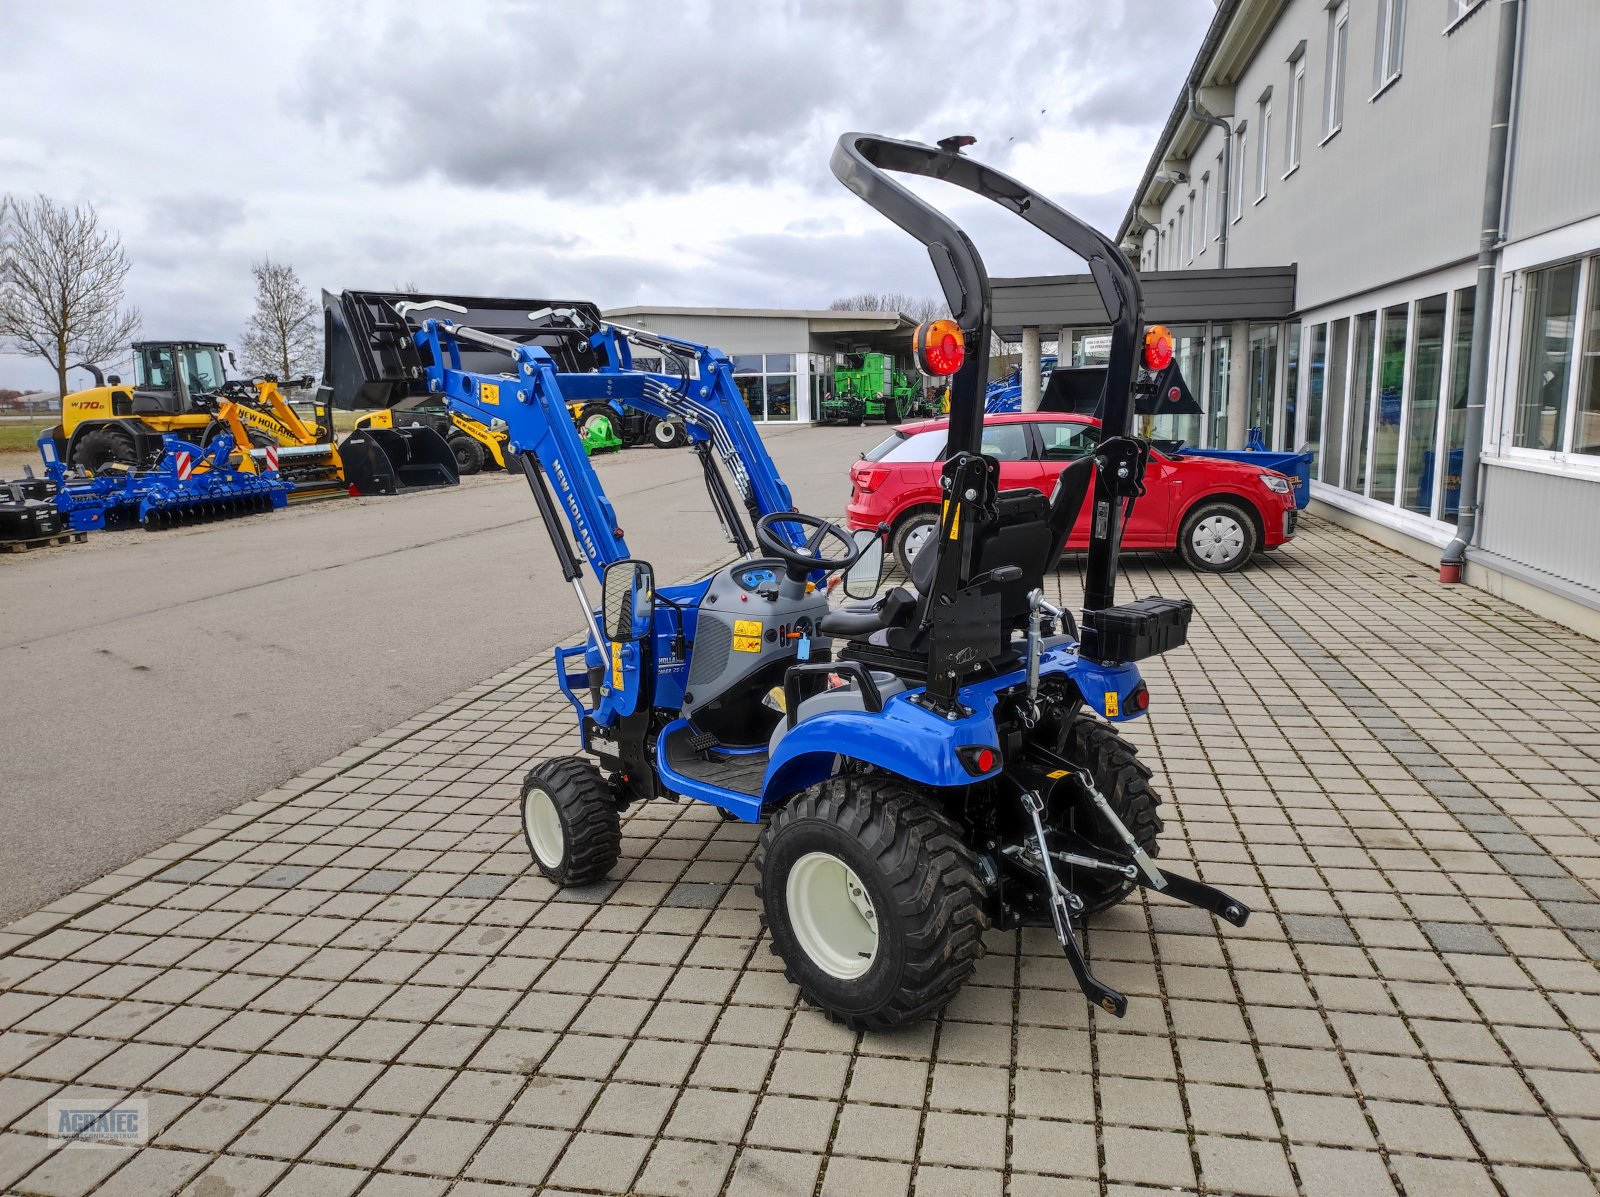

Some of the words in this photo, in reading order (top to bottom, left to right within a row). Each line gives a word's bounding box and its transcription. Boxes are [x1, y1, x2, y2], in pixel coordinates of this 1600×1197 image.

[239, 409, 257, 421] NEW
[456, 419, 467, 429] NEW
[467, 425, 488, 440] HOLLAND
[552, 458, 570, 493] NEW
[566, 493, 597, 560] HOLLAND
